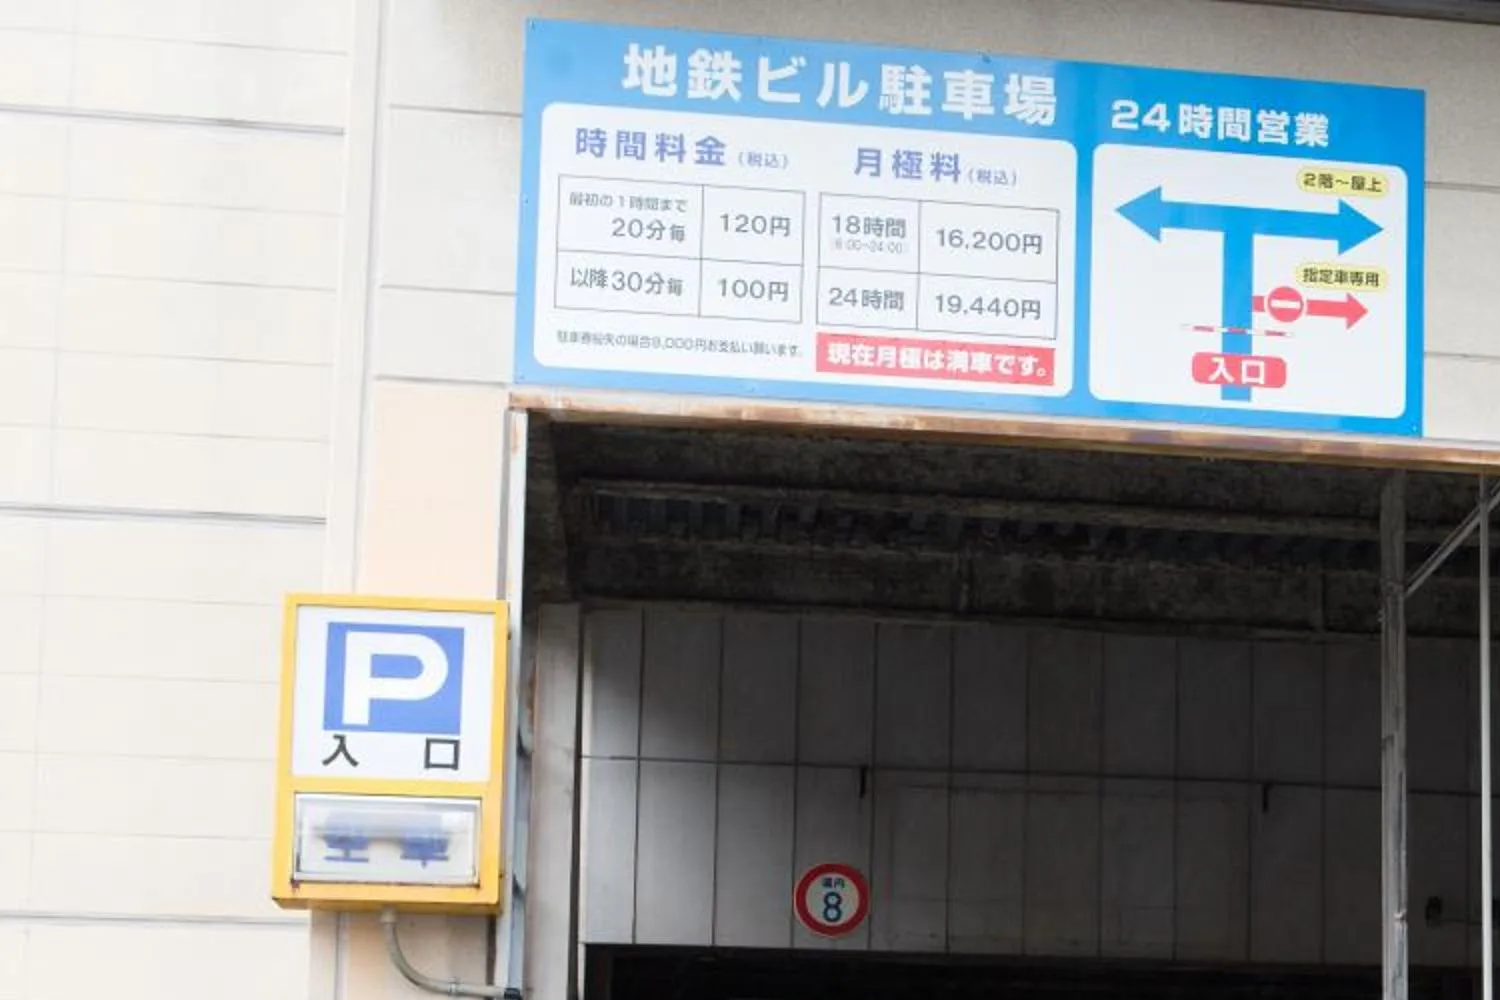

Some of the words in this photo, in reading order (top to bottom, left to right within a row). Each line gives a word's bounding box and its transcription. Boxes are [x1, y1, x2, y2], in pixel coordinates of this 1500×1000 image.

[621, 43, 1057, 128] 地鉄ビル駐車場
[1110, 99, 1329, 148] 24時間営業
[575, 127, 727, 168] 時間料金
[853, 148, 962, 184] 月極料
[611, 217, 686, 242] 20分毎
[720, 213, 791, 237] 120円
[832, 215, 907, 239] 18時間
[937, 229, 1043, 255] 16,200円
[570, 266, 684, 296] 以降30分毎
[719, 278, 790, 302] 100円
[1303, 267, 1380, 288] 指定車専用
[829, 287, 905, 311] 24時間
[935, 295, 1042, 321] 19,440円
[827, 342, 1047, 377] 現在月極は満車です。
[1208, 357, 1266, 385] 入口
[341, 630, 449, 726] P
[322, 734, 461, 771] 入口
[824, 891, 842, 923] 8
